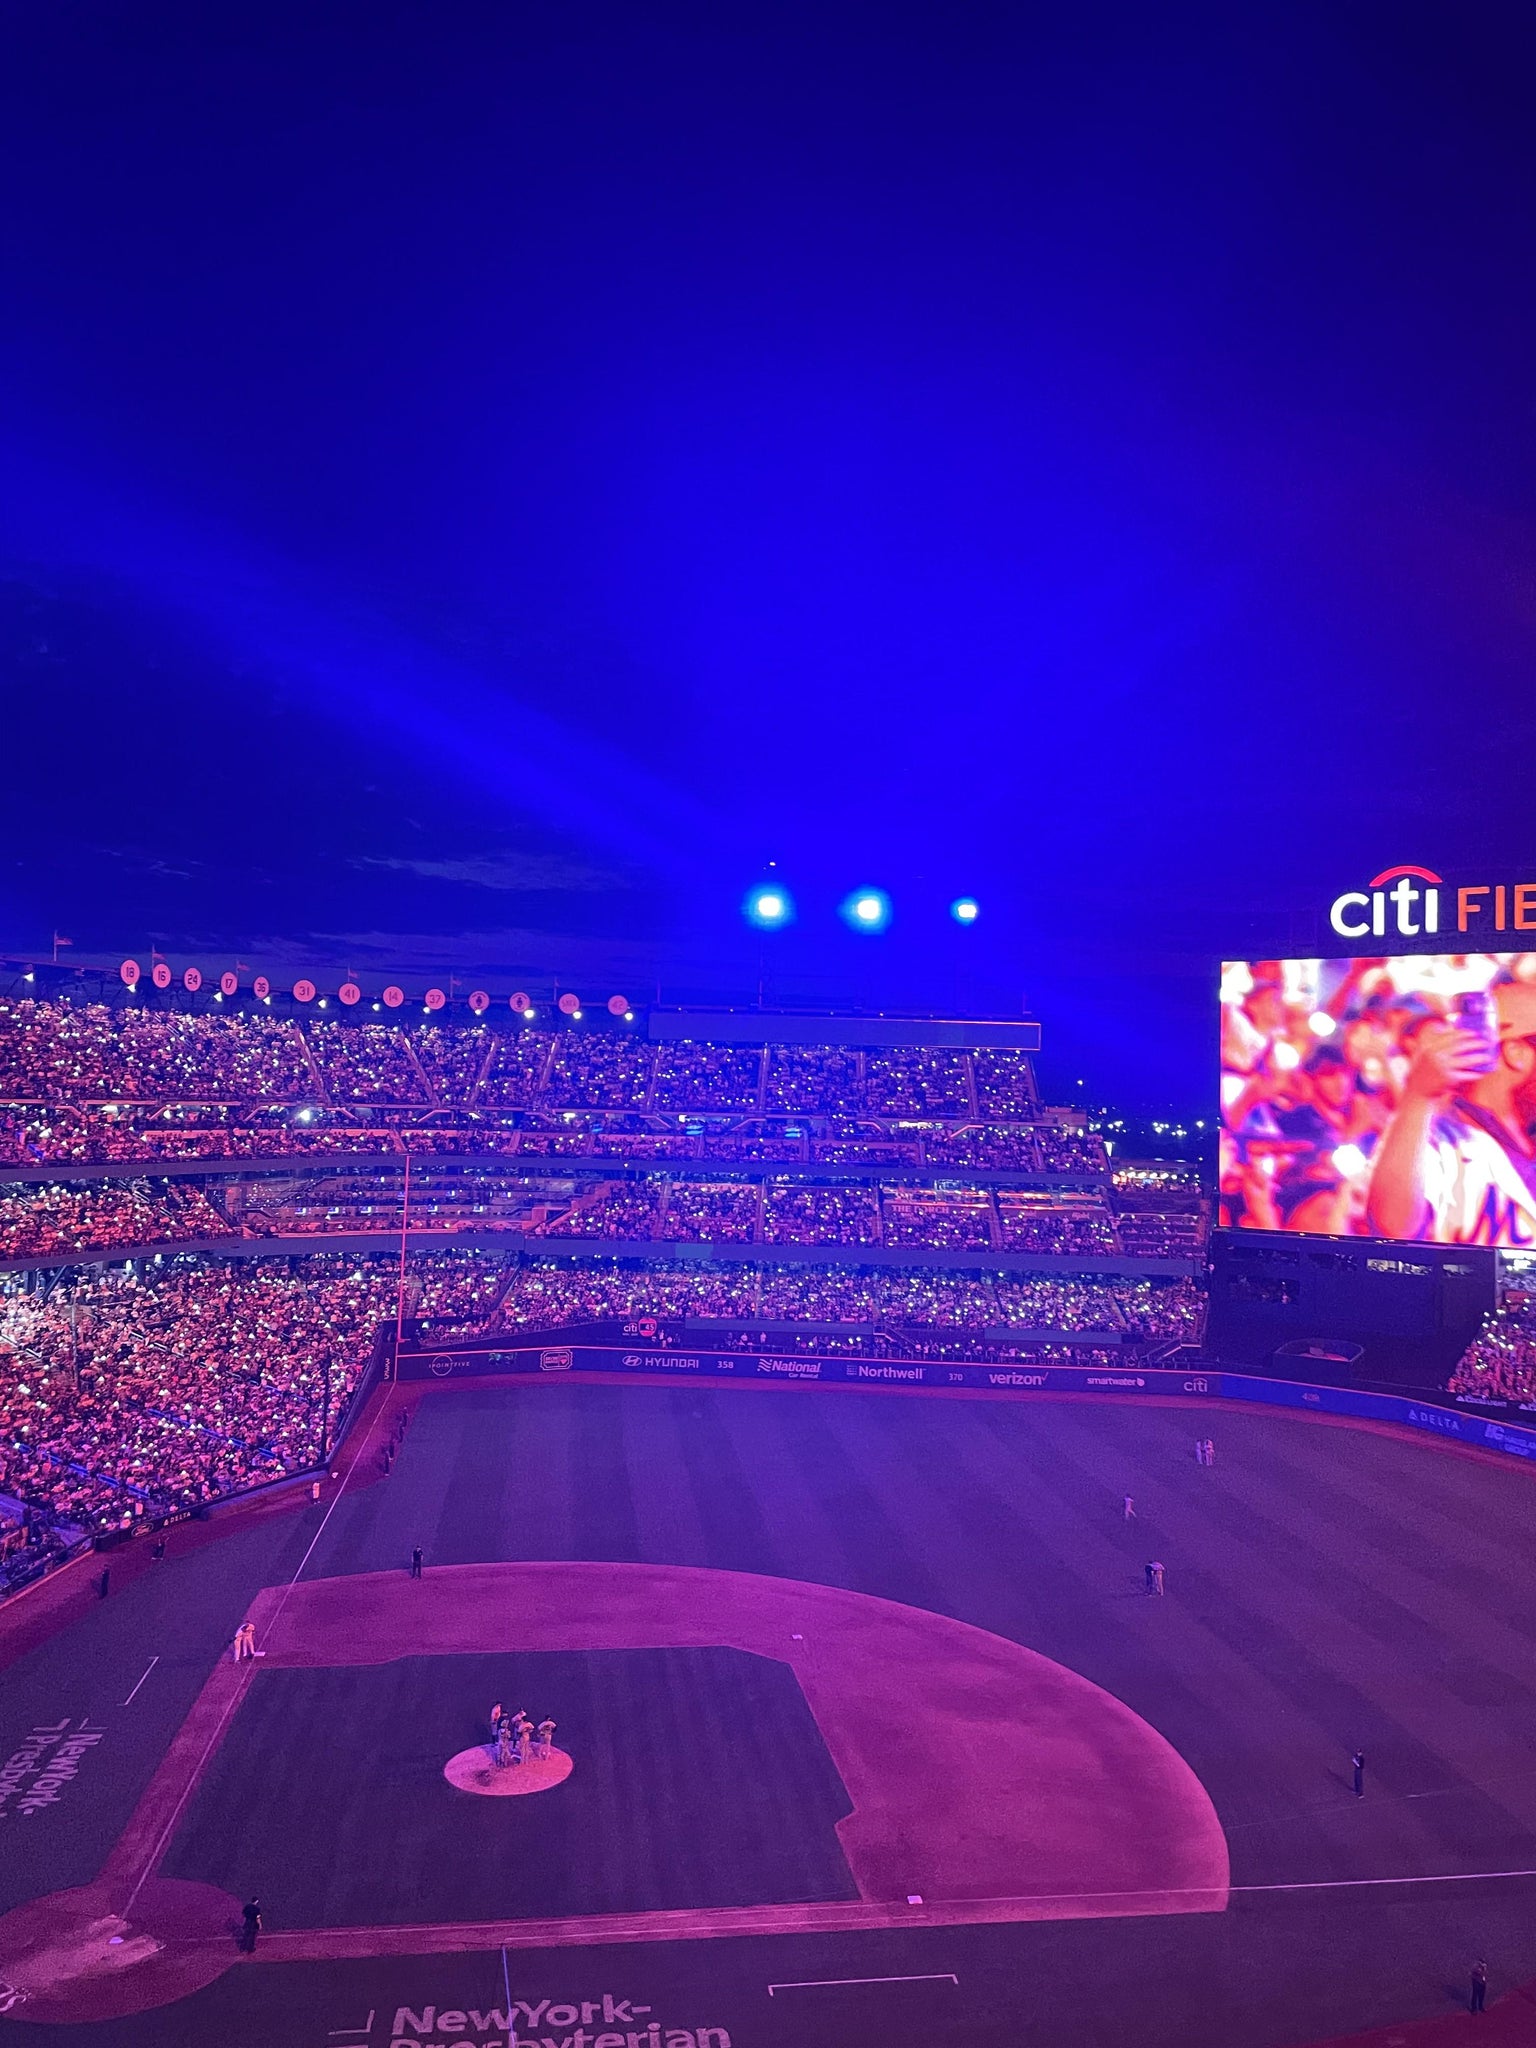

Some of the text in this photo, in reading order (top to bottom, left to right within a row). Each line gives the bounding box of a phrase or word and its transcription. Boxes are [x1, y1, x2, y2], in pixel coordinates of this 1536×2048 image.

[1330, 877, 1439, 937] citi
[645, 1357, 699, 1368] HYUNDAI
[717, 1360, 734, 1369] 358
[772, 1360, 821, 1373] National
[858, 1365, 923, 1380] Northwell
[949, 1372, 963, 1381] 370
[989, 1371, 1042, 1385] verizon
[1087, 1377, 1136, 1386] smartwater
[1183, 1378, 1208, 1393] citi
[1420, 1411, 1460, 1431] DELTA
[392, 1994, 652, 2035] NewYork-
